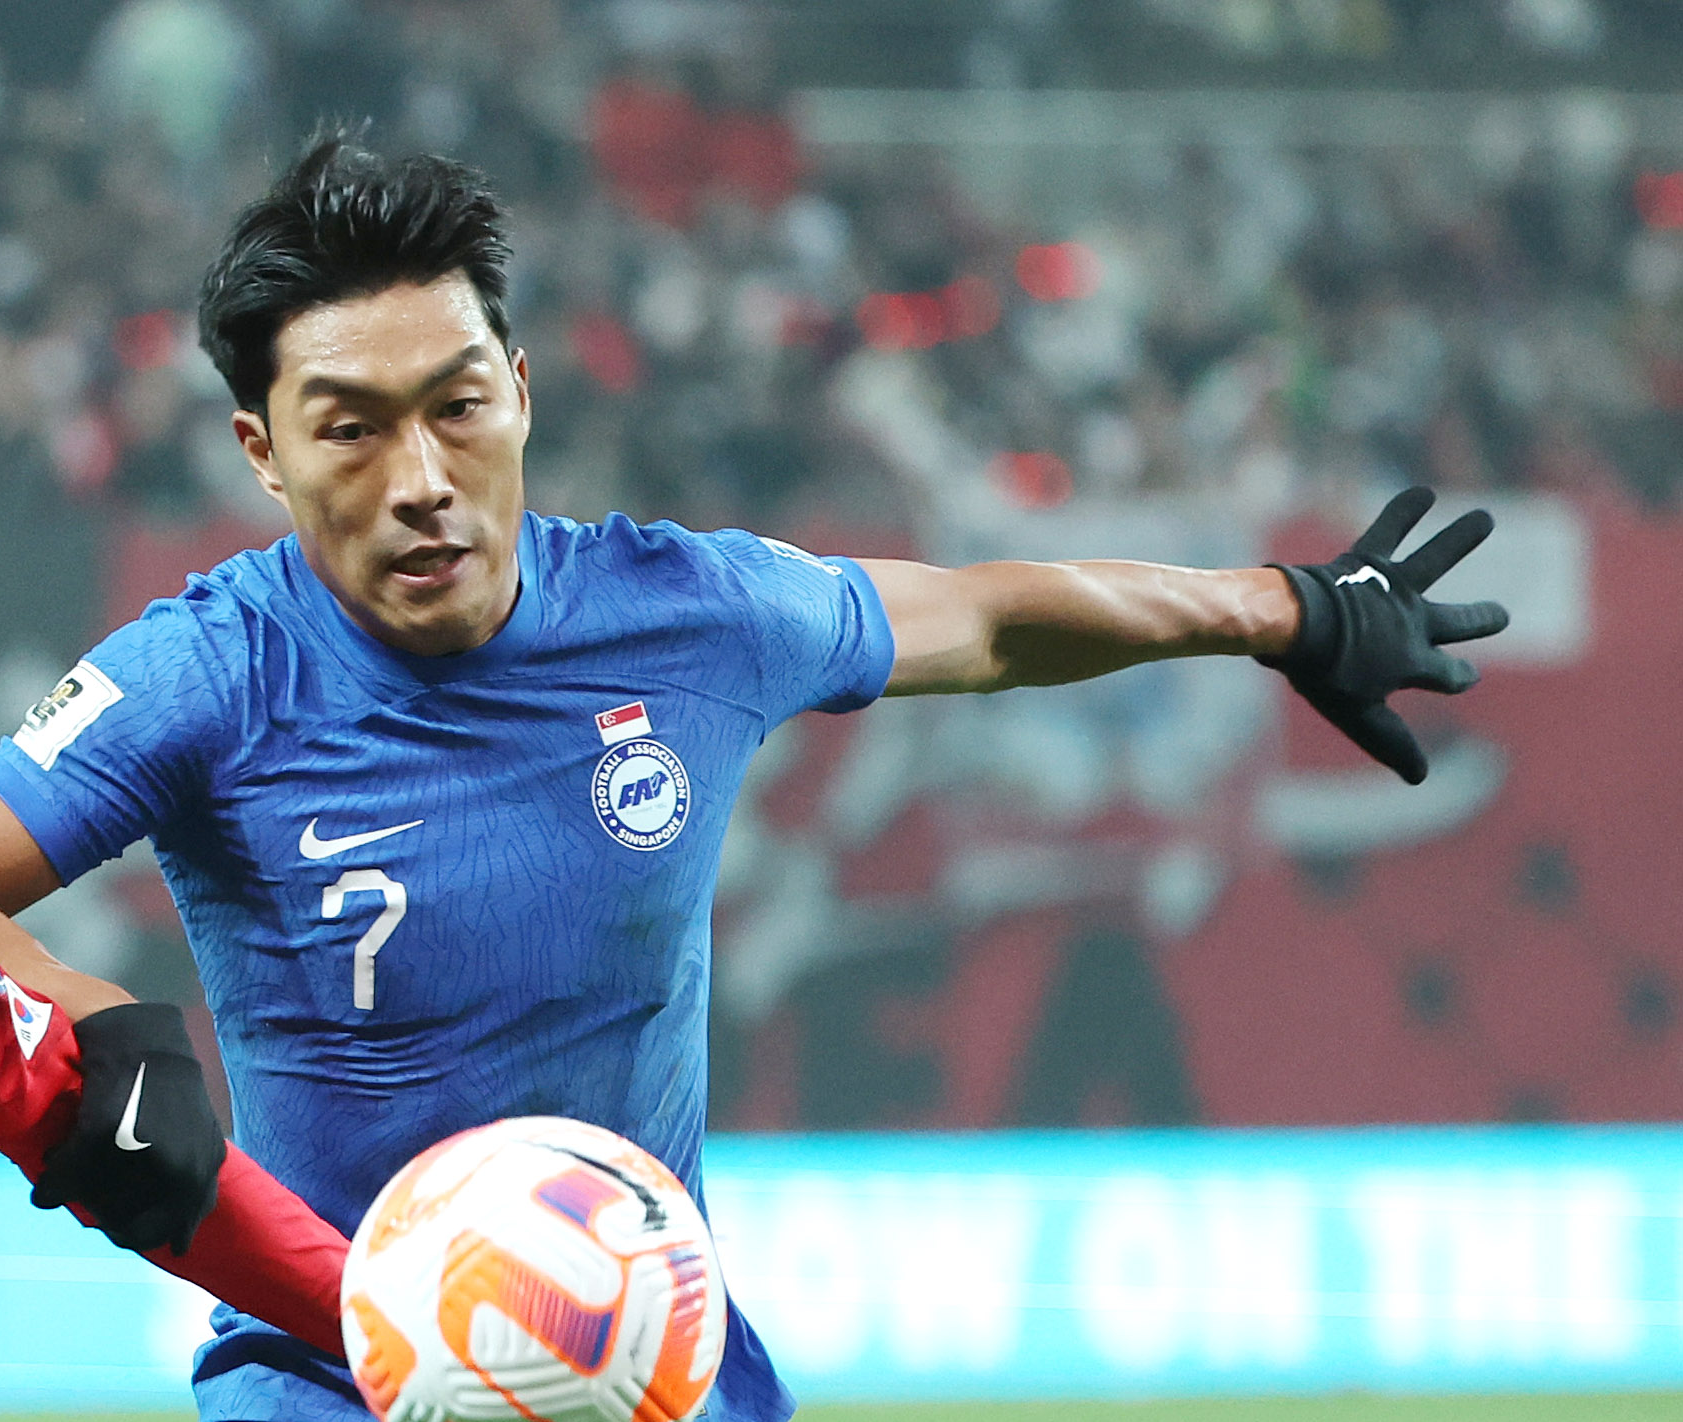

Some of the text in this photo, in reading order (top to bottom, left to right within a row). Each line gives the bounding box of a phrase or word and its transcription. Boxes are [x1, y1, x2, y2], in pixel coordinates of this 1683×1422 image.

[596, 743, 687, 816] FOOTBALL ASSOCIATION
[617, 816, 682, 847] SINGAPORE
[321, 869, 408, 1011] 7
